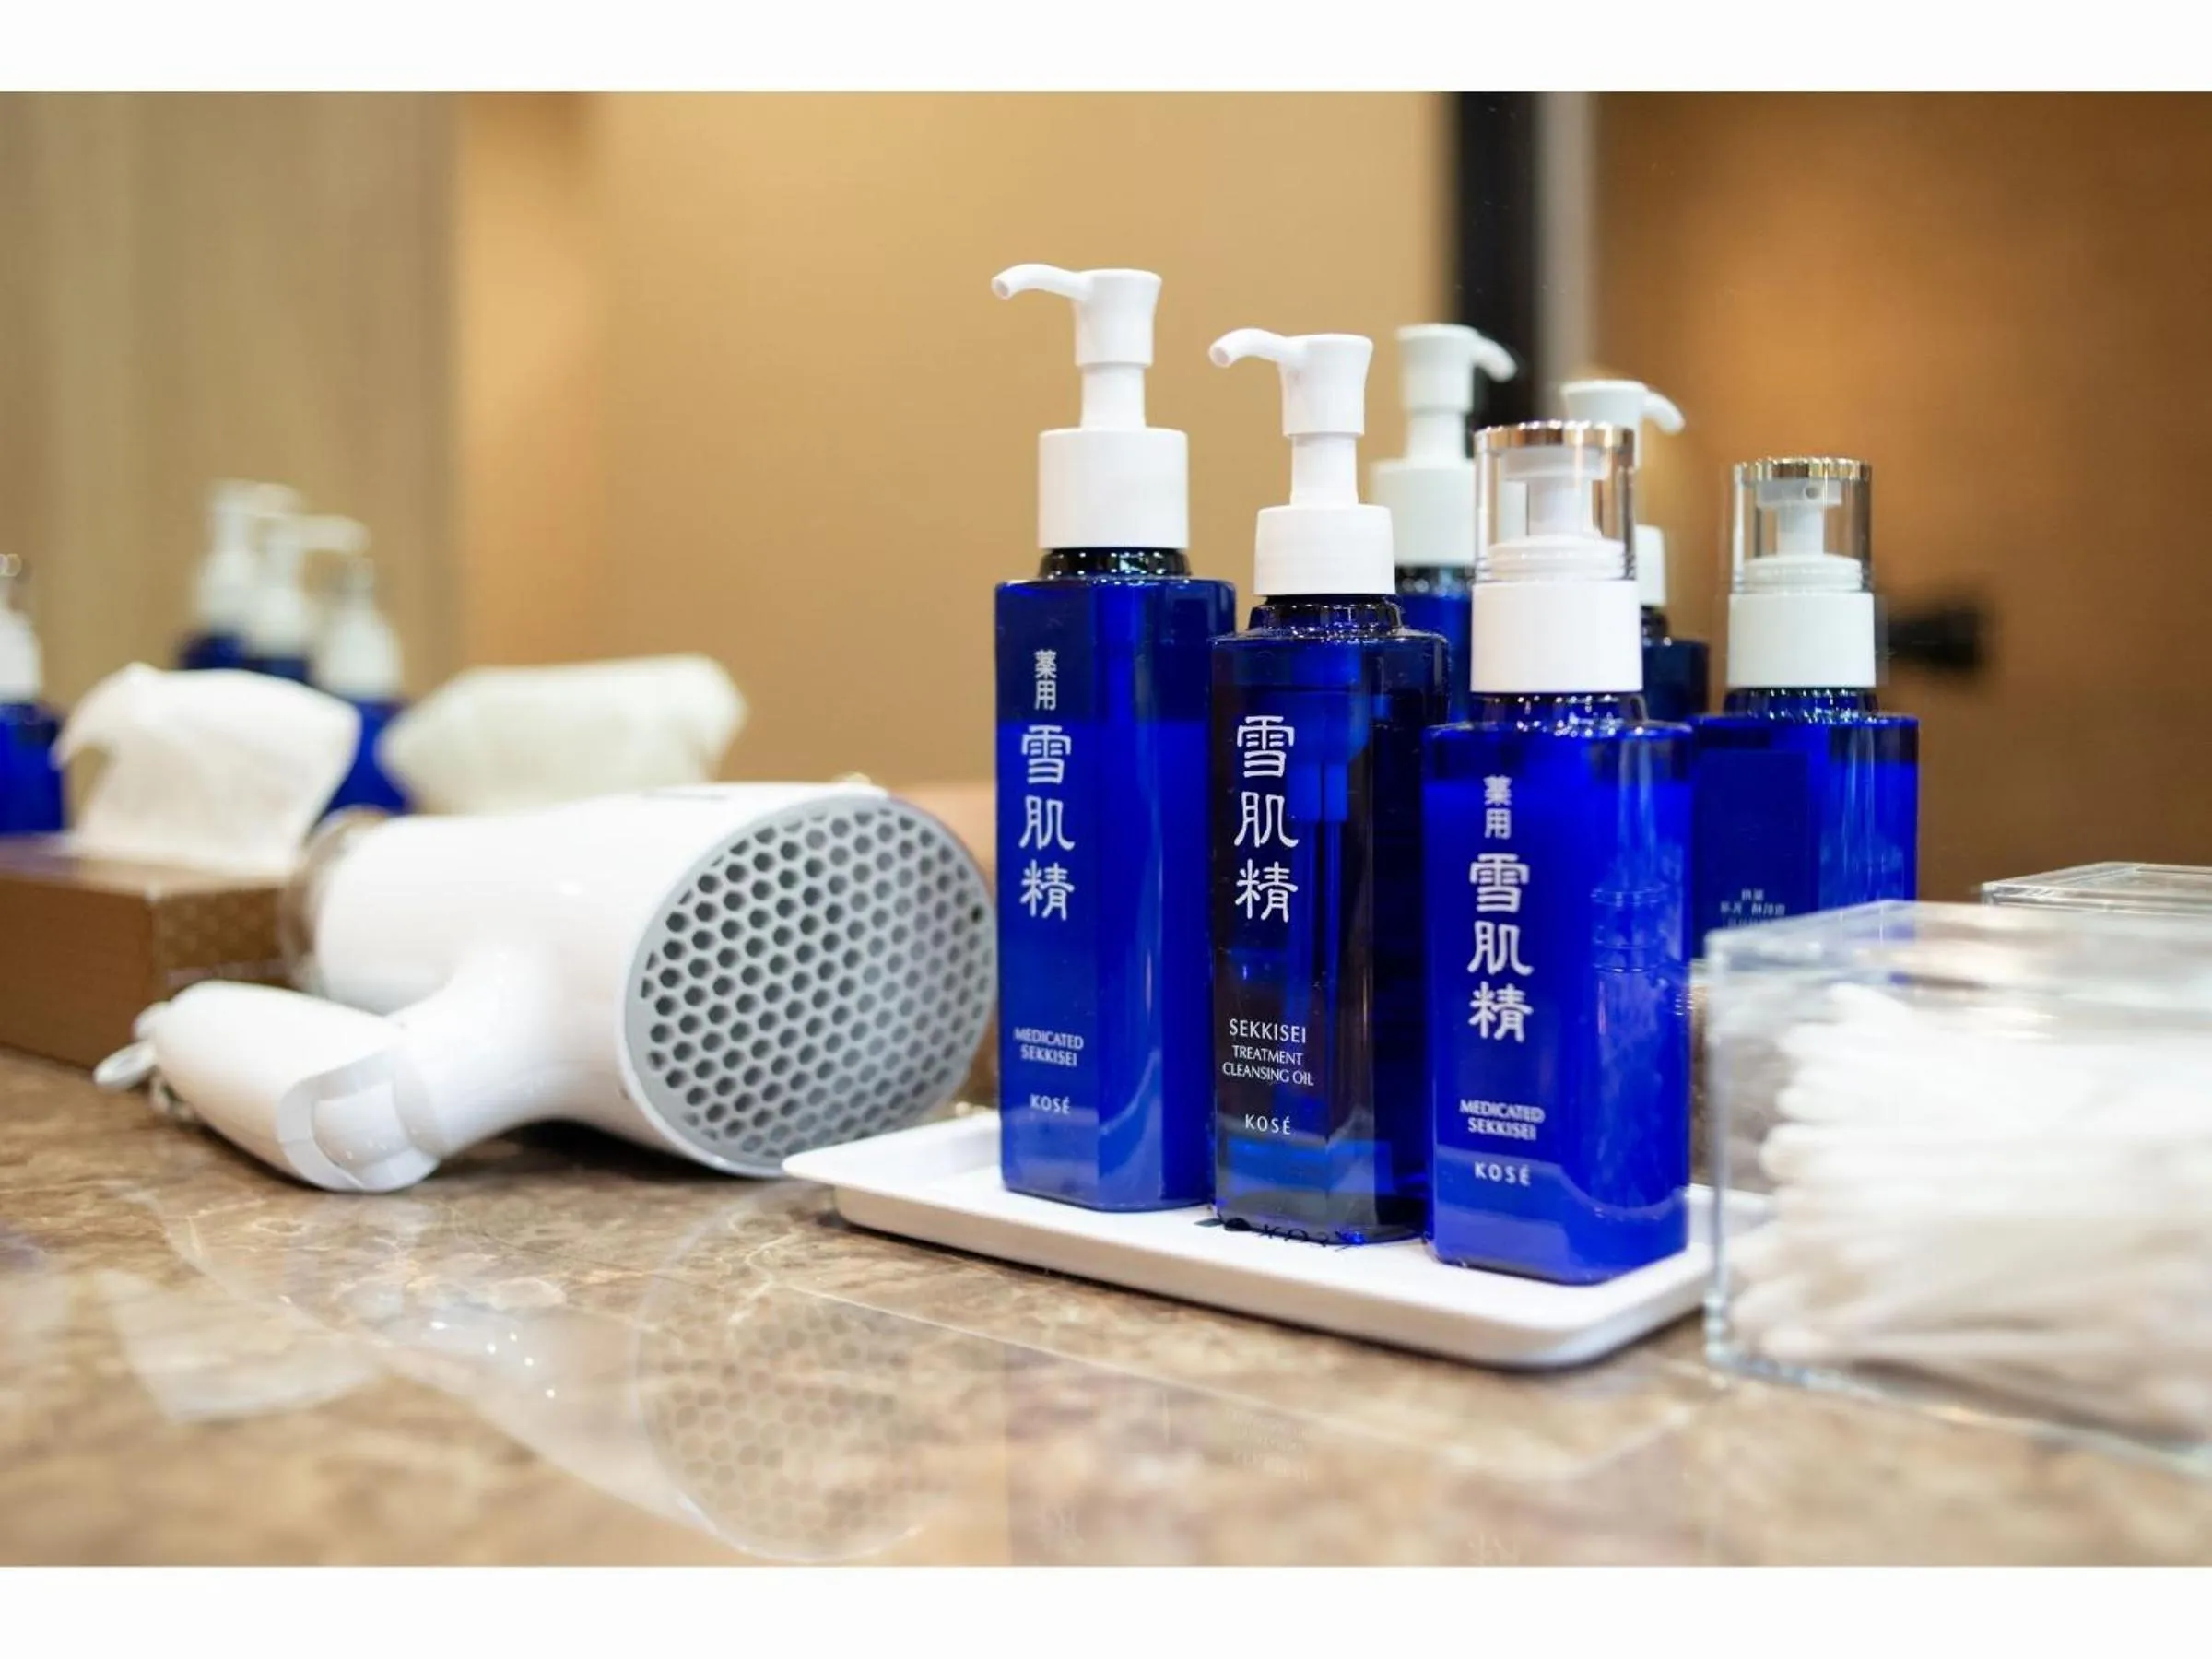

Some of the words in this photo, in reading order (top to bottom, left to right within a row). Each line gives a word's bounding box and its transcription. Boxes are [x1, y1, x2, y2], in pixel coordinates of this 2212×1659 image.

[1018, 724, 1076, 921] 雪肌精
[1233, 714, 1300, 923] 雪肌精
[1466, 853, 1534, 1042] 雪肌精
[1014, 1026, 1085, 1050] MEDICATED
[1229, 1018, 1307, 1044] SEKKISEI
[1020, 1043, 1077, 1067] SEKKISEI
[1231, 1044, 1304, 1066] TREATMENT
[1222, 1061, 1290, 1083] CLEANSING
[1292, 1069, 1315, 1087] OIL
[1030, 1093, 1071, 1115] KOSÉ
[1460, 1098, 1546, 1124] MEDICATED
[1244, 1113, 1292, 1135] KOSÉ
